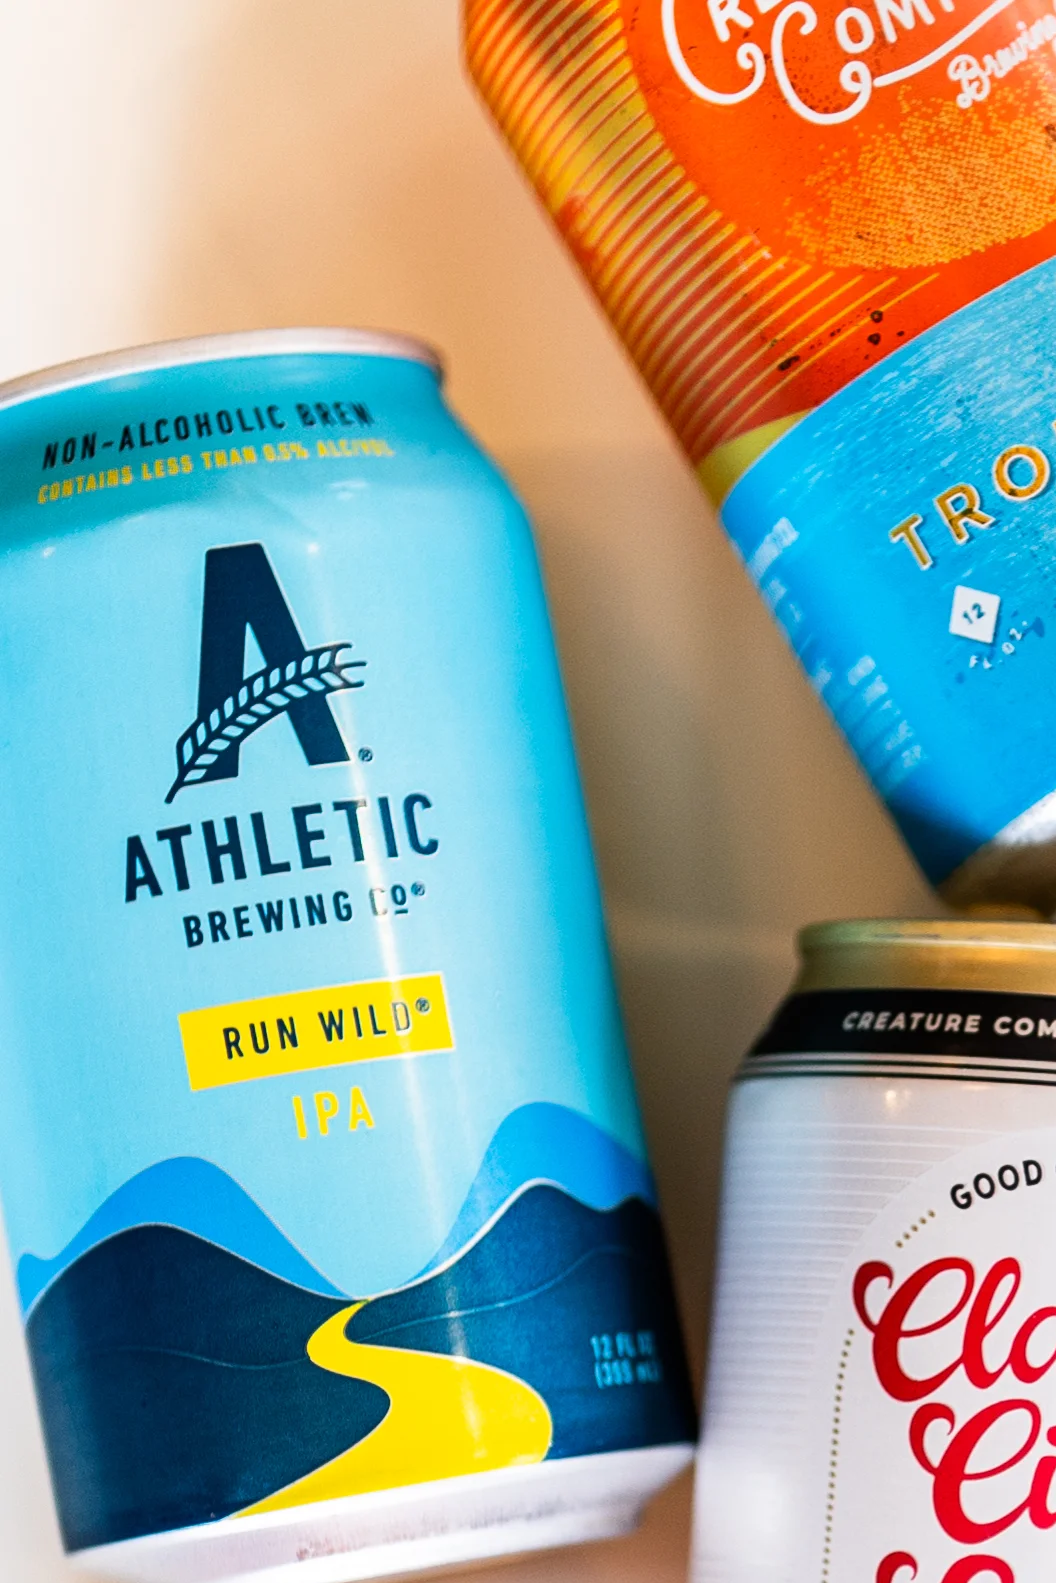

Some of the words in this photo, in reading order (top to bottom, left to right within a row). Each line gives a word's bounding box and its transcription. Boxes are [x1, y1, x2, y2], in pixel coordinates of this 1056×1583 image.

[42, 404, 287, 471] NON-ALCOHOLIC
[294, 401, 376, 428] BREW
[37, 466, 133, 504] CONTAINS
[141, 455, 193, 480] LESS
[201, 446, 257, 469] THAN
[262, 442, 309, 463] 0.5%
[124, 792, 440, 904] ATHLETIC
[183, 888, 354, 949] BREWING
[222, 1008, 301, 1060] RUN
[842, 1010, 981, 1034] CREATURE
[291, 1086, 376, 1139] IPA
[949, 1158, 1044, 1211] GOOD
